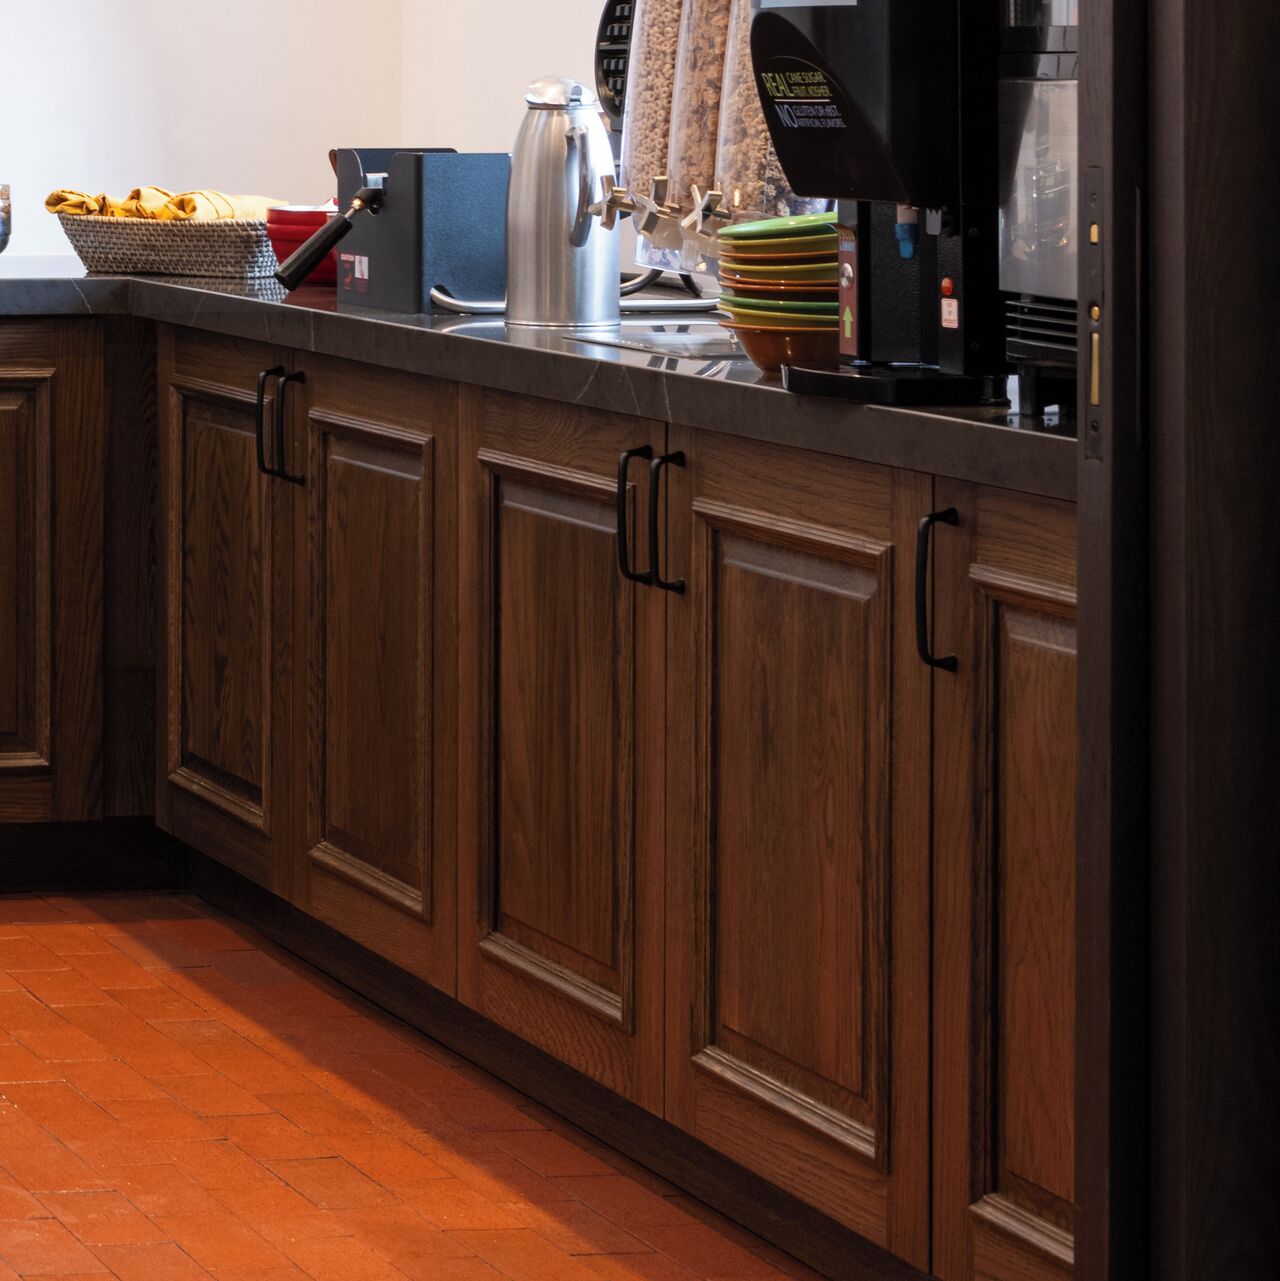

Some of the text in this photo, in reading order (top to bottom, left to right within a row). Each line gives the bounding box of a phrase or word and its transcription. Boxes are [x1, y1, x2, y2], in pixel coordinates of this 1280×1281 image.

[761, 72, 795, 96] REAL
[785, 72, 803, 83] CANE
[774, 104, 798, 128] NO
